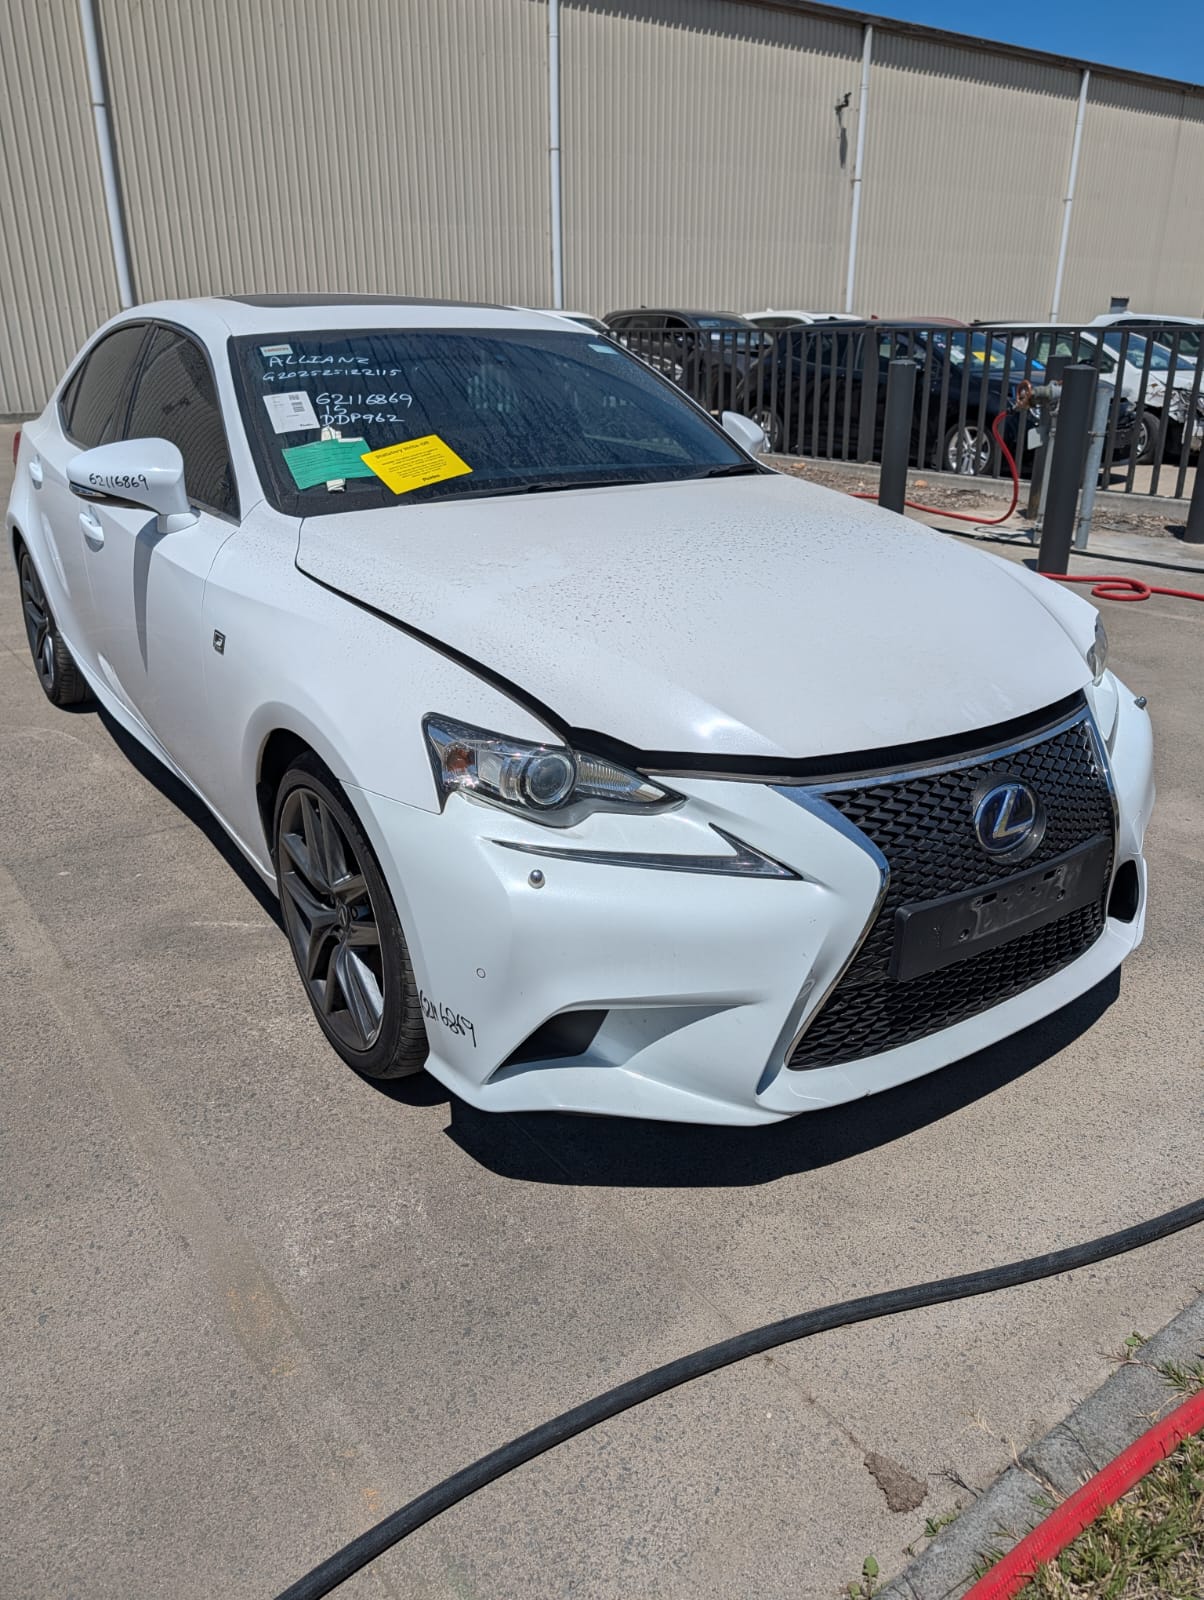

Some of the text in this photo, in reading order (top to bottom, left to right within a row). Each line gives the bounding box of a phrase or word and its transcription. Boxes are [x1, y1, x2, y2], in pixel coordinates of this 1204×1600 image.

[270, 355, 370, 368] ALLIANZ
[315, 392, 413, 409] 62116869
[320, 412, 406, 427] DDP962
[88, 472, 150, 492] 62116869
